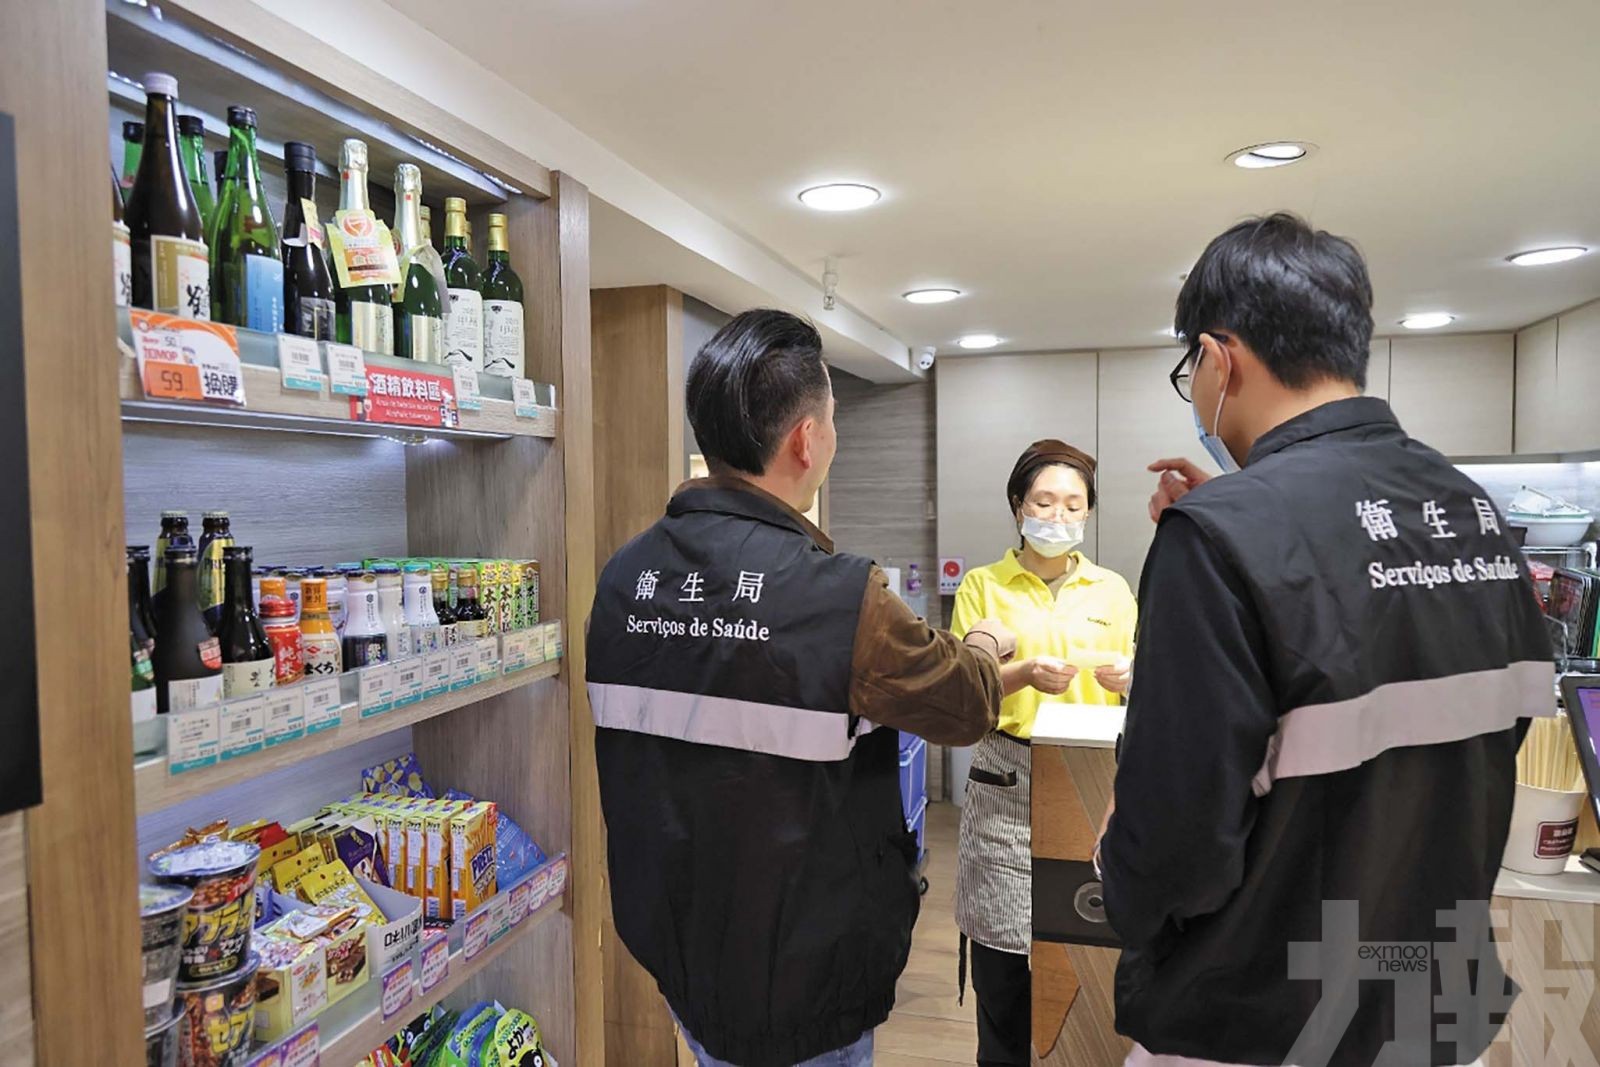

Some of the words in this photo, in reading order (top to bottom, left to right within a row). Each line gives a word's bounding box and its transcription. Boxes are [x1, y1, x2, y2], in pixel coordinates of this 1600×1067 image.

[161, 370, 184, 392] 59
[203, 371, 238, 396] 換購
[369, 372, 441, 402] 酒精飲料區
[1355, 497, 1501, 541] 衛生局
[635, 569, 765, 604] 衛生局
[1368, 561, 1451, 589] Serviços
[1452, 558, 1475, 584] de
[1474, 555, 1520, 582] Saúde
[626, 614, 686, 638] Serviços
[689, 617, 709, 637] de
[712, 618, 770, 641] Saúde
[471, 846, 494, 881] PRETZ
